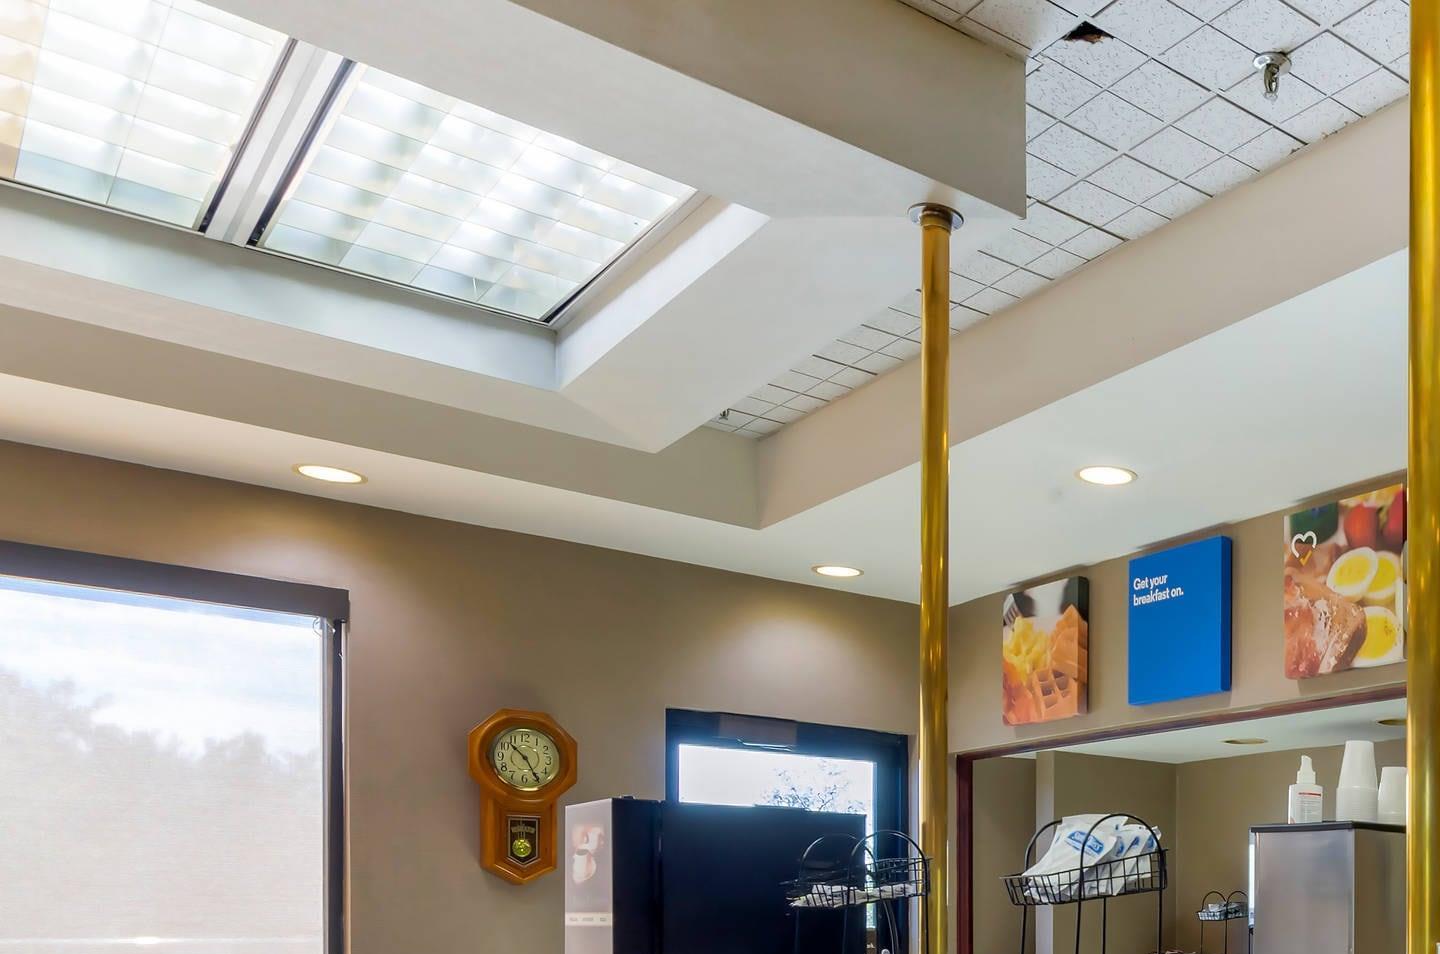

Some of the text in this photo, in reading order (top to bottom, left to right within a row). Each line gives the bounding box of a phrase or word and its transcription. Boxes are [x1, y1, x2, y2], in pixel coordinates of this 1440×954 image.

[1134, 574, 1168, 590] Get your
[1133, 587, 1184, 606] breakfast on.
[509, 735, 517, 744] 11
[520, 733, 530, 743] 12
[535, 738, 539, 746] 1
[500, 742, 510, 751] 10
[543, 746, 549, 755] 2
[497, 752, 504, 761] 9
[545, 756, 552, 765] 3
[500, 762, 508, 772] 8
[508, 770, 516, 780] 7
[521, 774, 528, 784] 6
